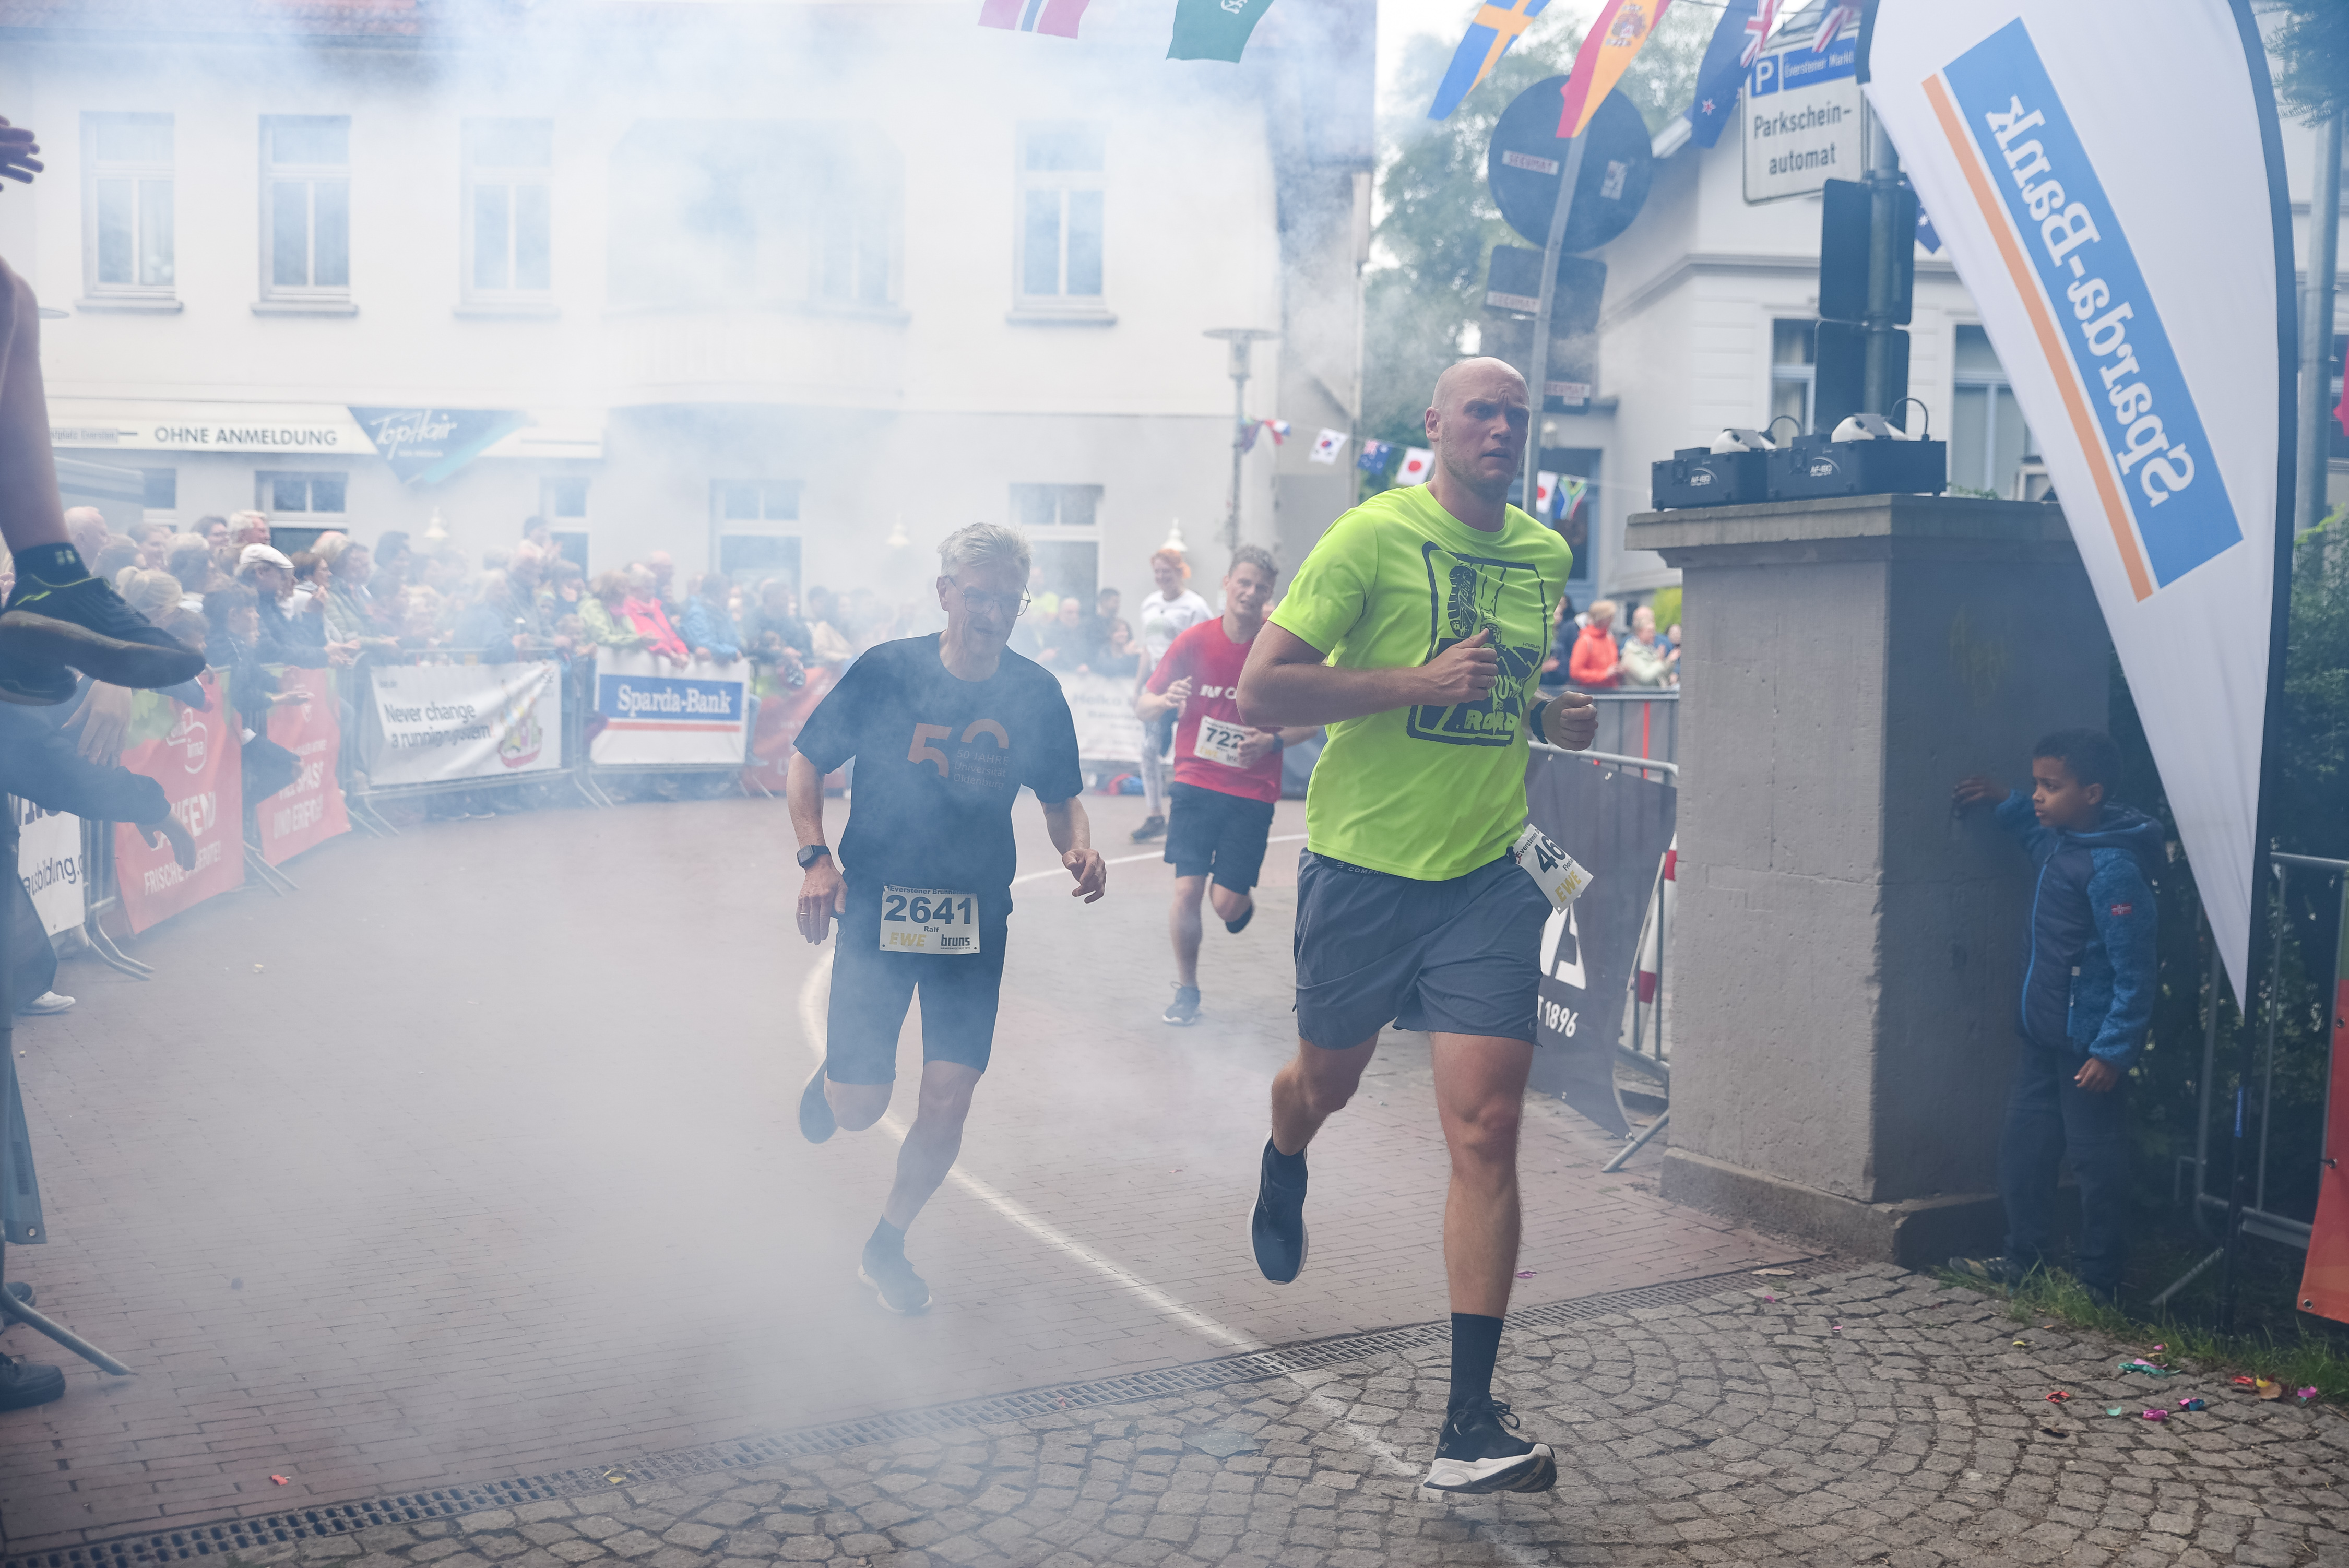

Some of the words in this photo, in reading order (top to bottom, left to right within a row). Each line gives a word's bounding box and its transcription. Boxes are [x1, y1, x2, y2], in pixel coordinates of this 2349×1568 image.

[1755, 59, 1774, 94] P
[1754, 100, 1853, 140] Parkschein-
[1769, 141, 1837, 176] automat
[155, 426, 210, 444] OHNE
[216, 429, 338, 446] ANMELDUNG
[384, 703, 422, 723] Never
[425, 700, 477, 723] change
[616, 684, 732, 718] Sparda-Bank
[1464, 709, 1518, 731] ROAD
[954, 761, 1007, 777] Universität
[956, 750, 970, 758] 50
[974, 752, 1009, 765] JAHRE
[953, 773, 1004, 791] Oldenburg
[1515, 833, 1538, 857] Everstener
[144, 861, 184, 896] FRISCHE
[1555, 870, 1582, 903] EWE
[889, 886, 931, 895] Everstener
[884, 894, 971, 925] 2641
[889, 932, 927, 947] EWE
[941, 934, 970, 947] bruns
[1545, 1000, 1579, 1038] 1896
